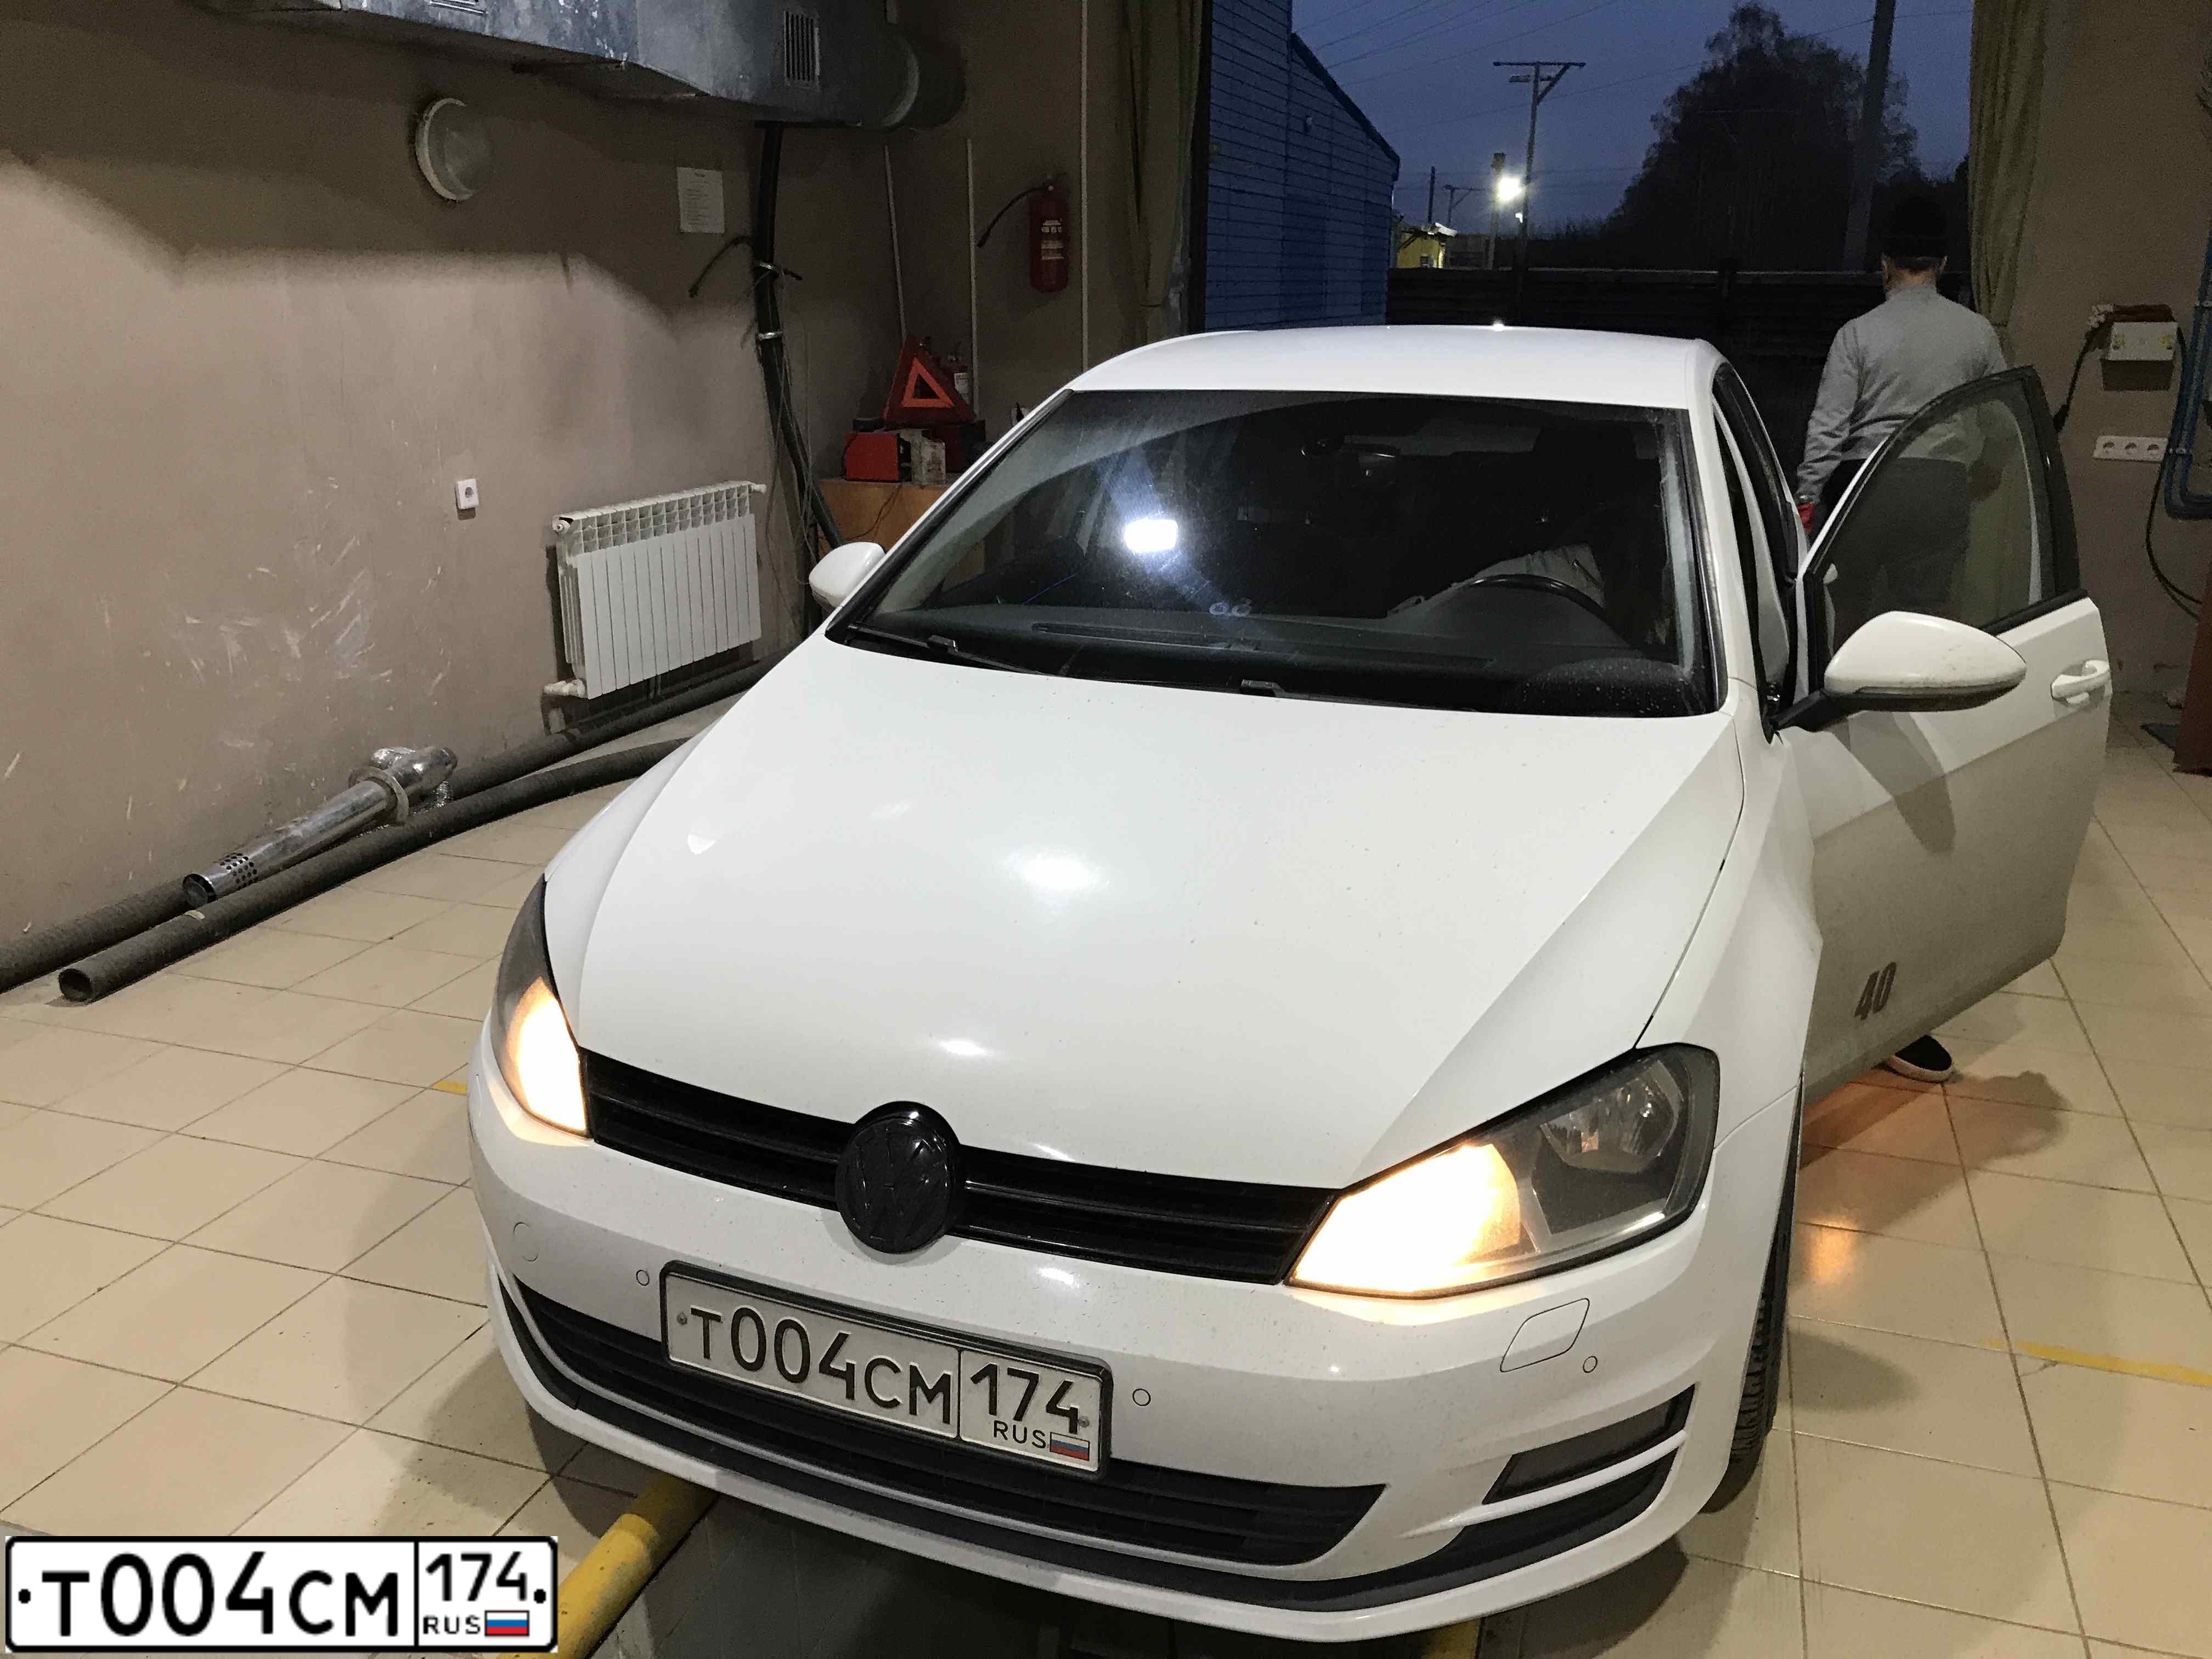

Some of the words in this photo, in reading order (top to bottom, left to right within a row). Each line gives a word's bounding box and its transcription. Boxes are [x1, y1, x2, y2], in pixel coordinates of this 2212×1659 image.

[1853, 961, 1898, 1022] 40
[969, 1363, 1080, 1435] 174
[993, 1419, 1047, 1449] RUS
